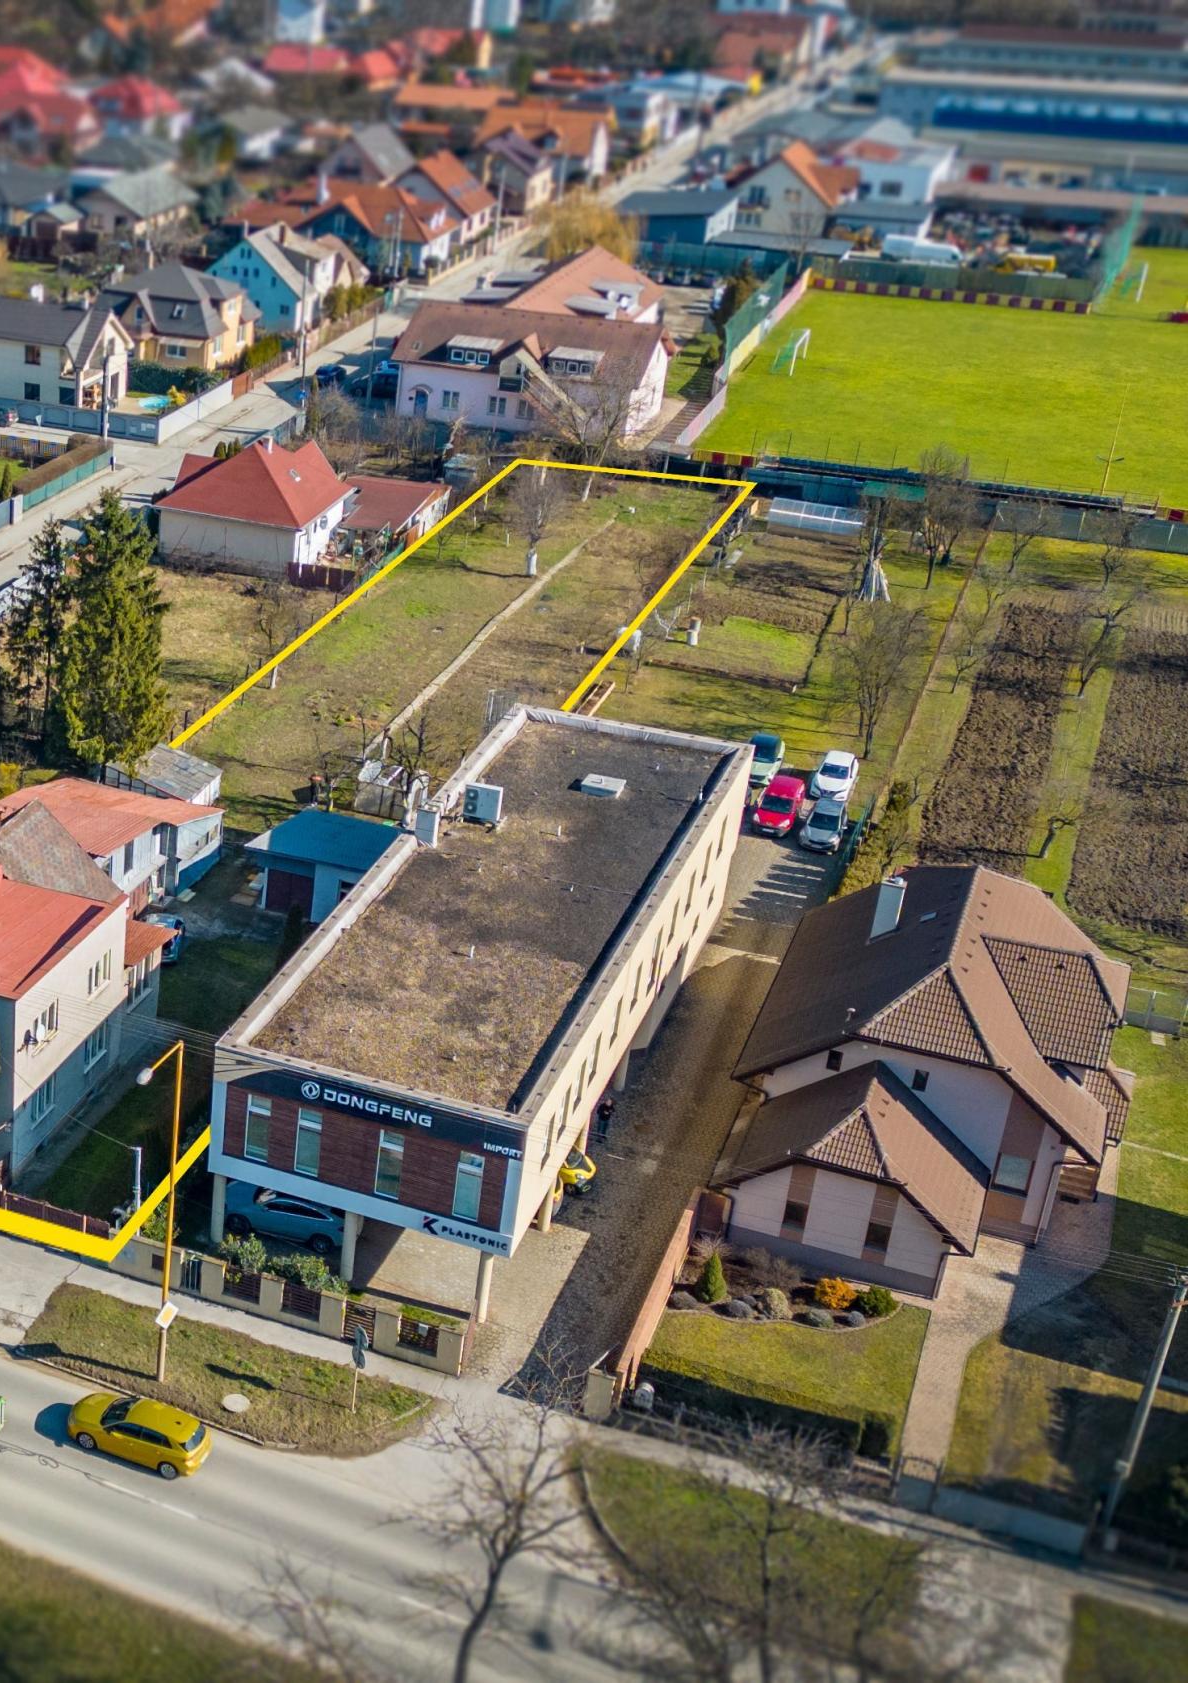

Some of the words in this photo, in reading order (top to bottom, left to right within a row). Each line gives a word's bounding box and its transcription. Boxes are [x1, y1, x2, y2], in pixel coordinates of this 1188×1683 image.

[323, 1090, 433, 1128] DONGFENG
[483, 1142, 523, 1158] IMPORT
[441, 1226, 508, 1251] PLASTONIC
